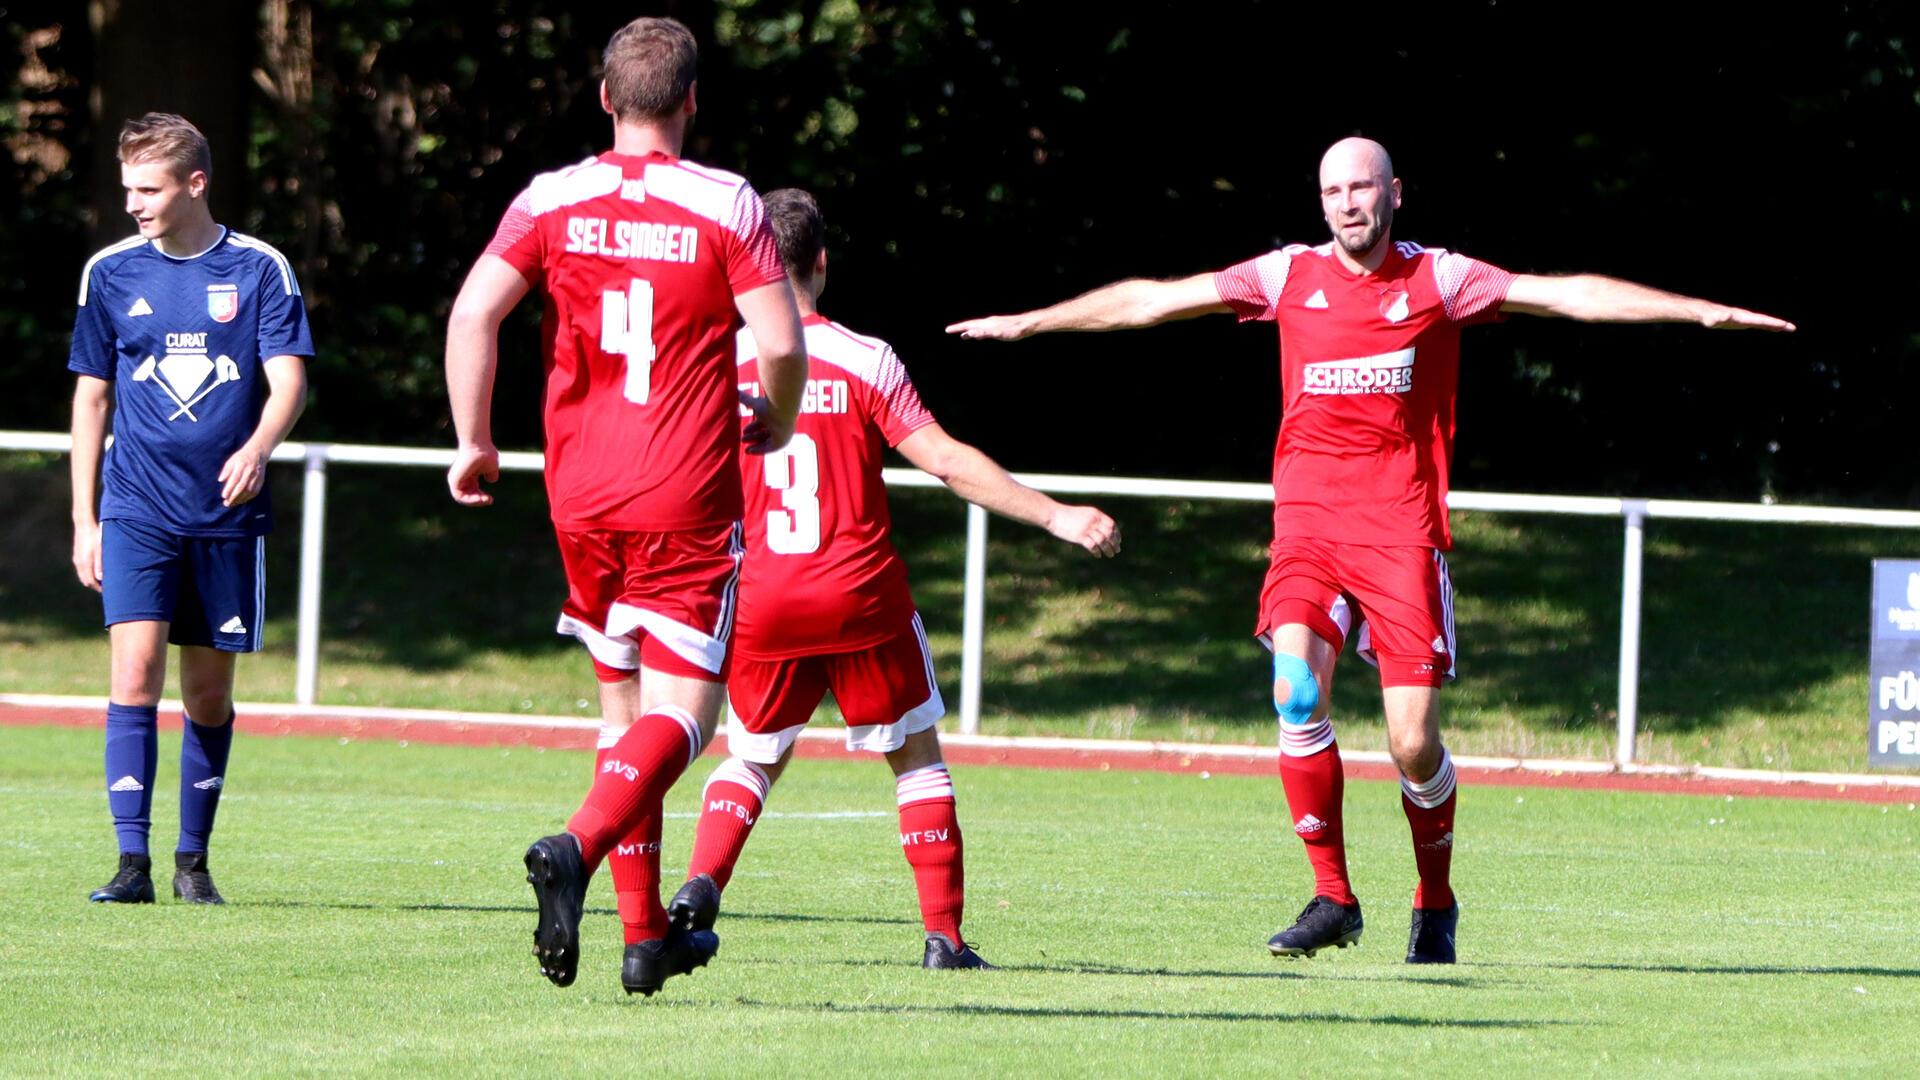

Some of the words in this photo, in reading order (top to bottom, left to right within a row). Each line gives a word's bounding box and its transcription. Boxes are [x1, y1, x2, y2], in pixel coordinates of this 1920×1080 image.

[566, 216, 698, 264] SELSINGEN
[165, 333, 208, 348] CURAT
[600, 278, 656, 405] 4
[764, 433, 820, 554] 3
[1879, 670, 1920, 711] FÜ
[1878, 720, 1920, 754] PE
[602, 759, 640, 782] SVS
[709, 799, 754, 826] MTSV
[900, 828, 948, 846] MTSV
